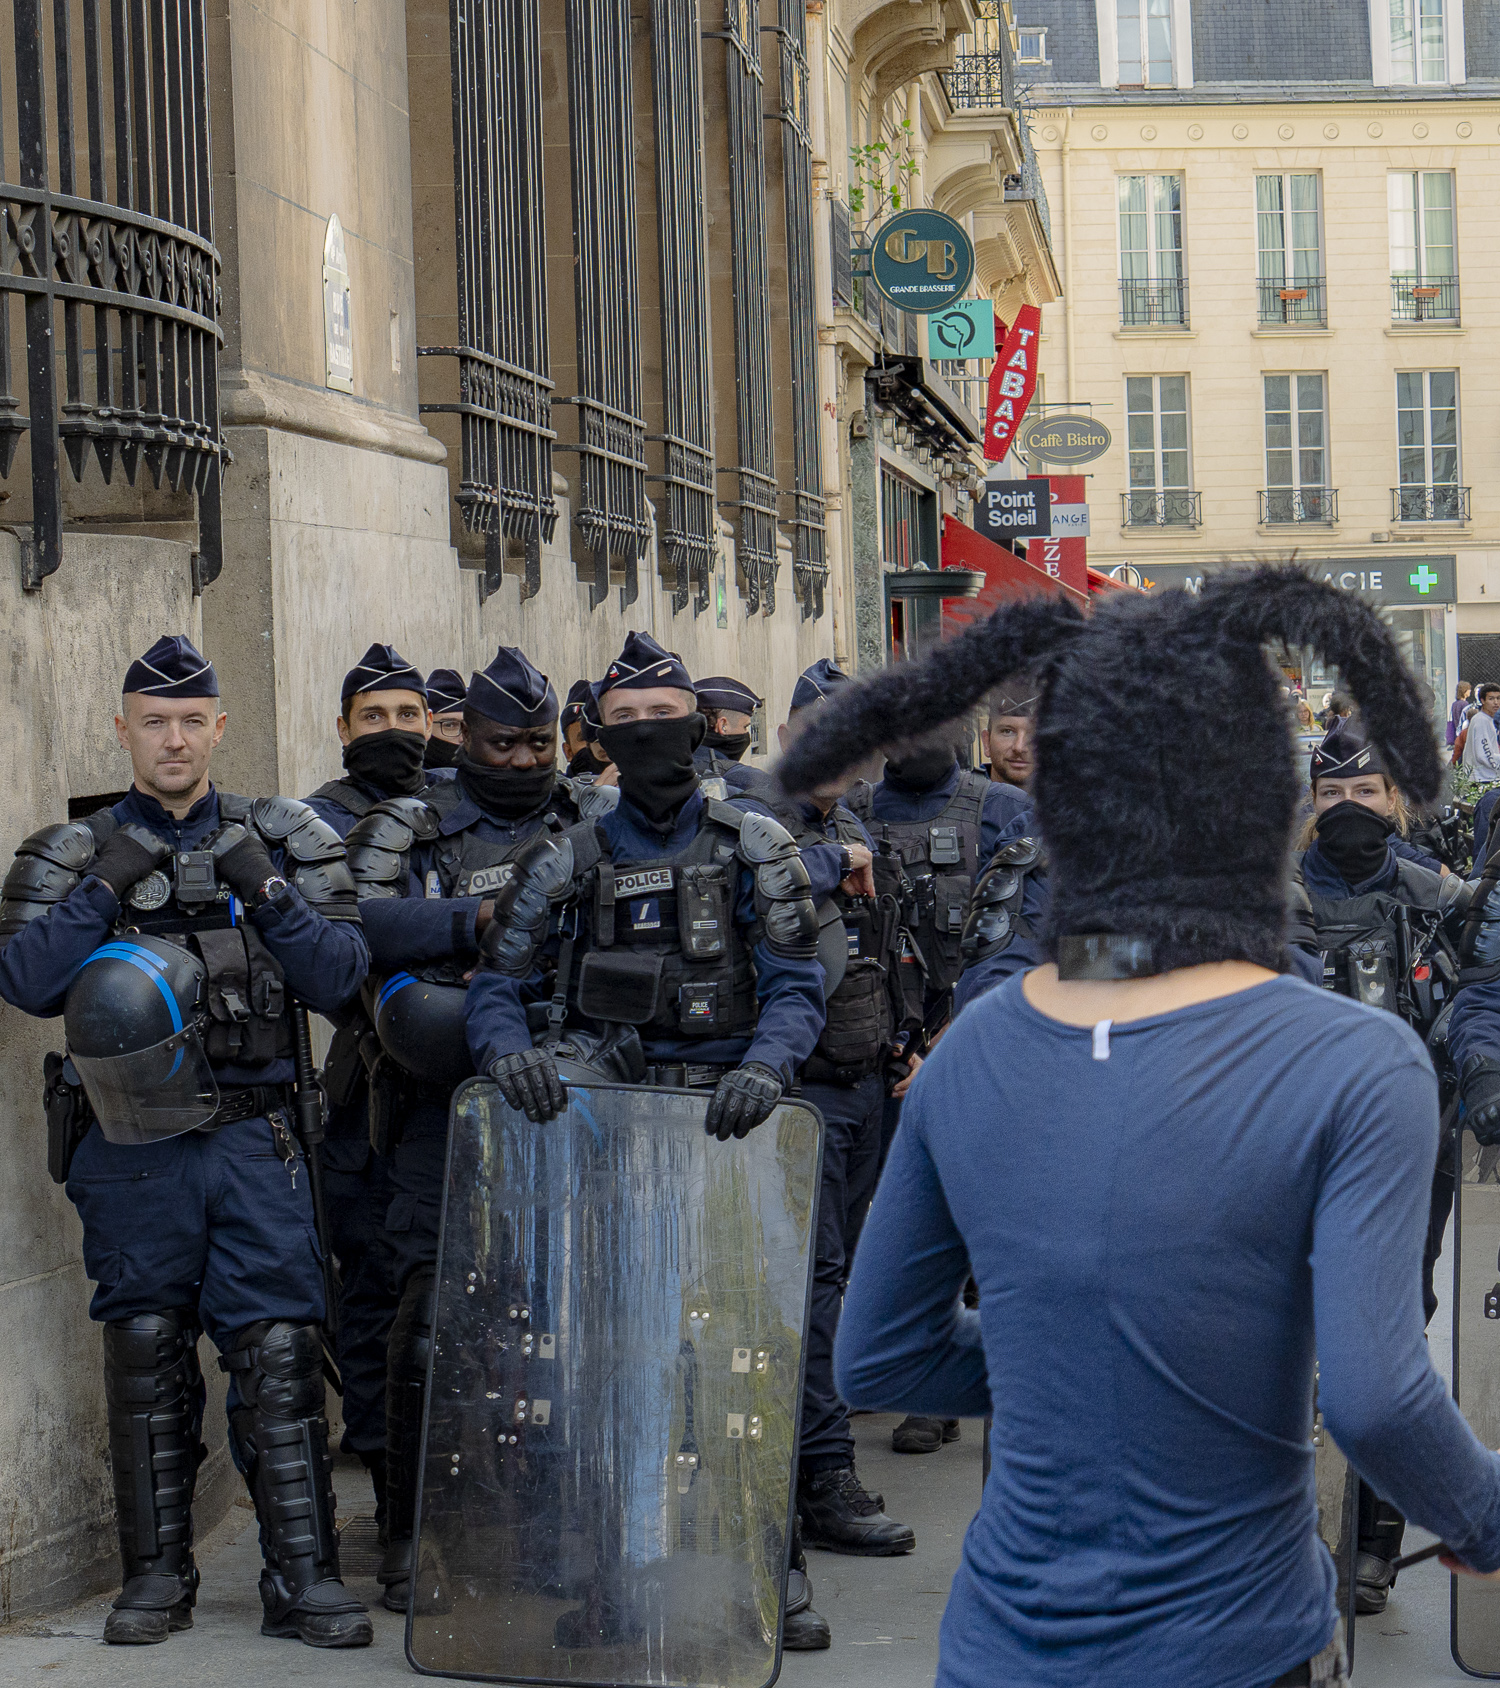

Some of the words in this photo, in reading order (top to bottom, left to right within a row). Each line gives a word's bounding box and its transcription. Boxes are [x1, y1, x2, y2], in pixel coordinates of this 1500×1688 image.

[889, 285, 918, 294] GRANDE
[919, 284, 956, 293] BRASSERIE
[992, 327, 1034, 439] TABAC
[1029, 433, 1063, 448] Caffè
[1067, 433, 1106, 447] Bistro
[987, 490, 1036, 509] Point
[988, 508, 1037, 527] Soleil
[1051, 513, 1087, 525] ANGE
[472, 868, 514, 889] OLIC
[615, 871, 669, 892] POLICE
